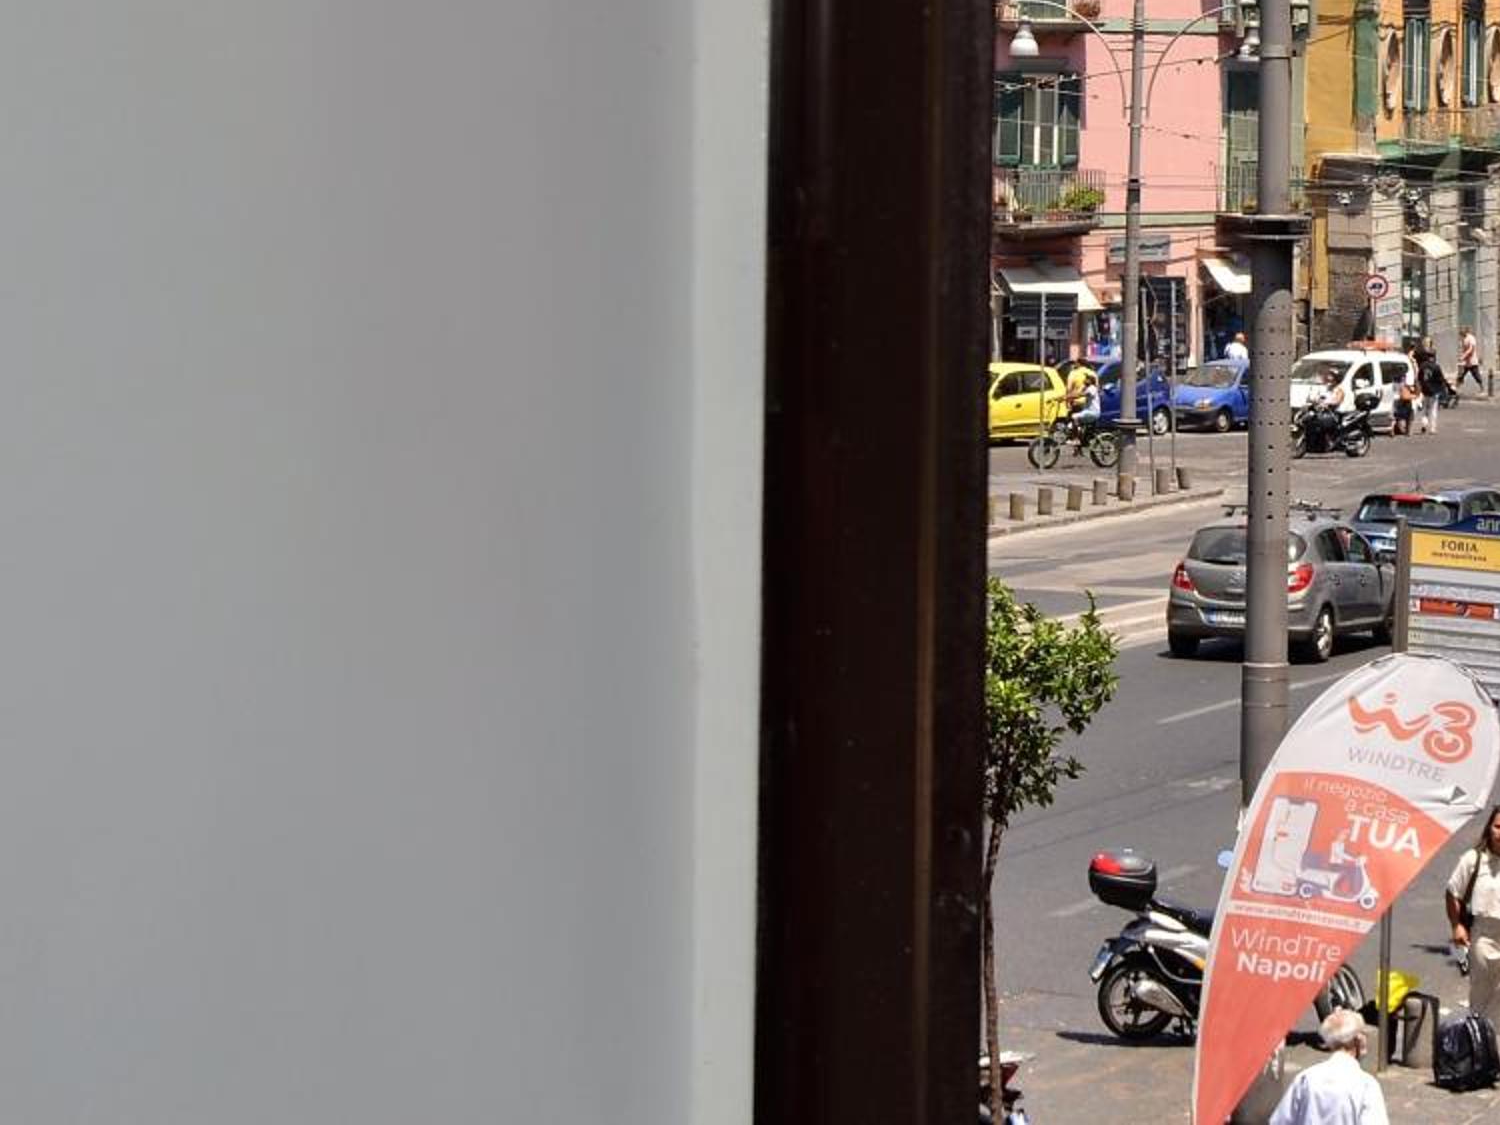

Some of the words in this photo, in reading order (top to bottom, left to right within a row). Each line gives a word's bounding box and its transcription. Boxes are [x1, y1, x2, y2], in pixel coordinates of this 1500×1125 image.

[1349, 746, 1446, 782] WINDTRE
[1363, 802, 1410, 824] casa
[1347, 812, 1421, 858] TUA
[1231, 926, 1341, 962] WindTre
[1236, 951, 1328, 983] Napoli
